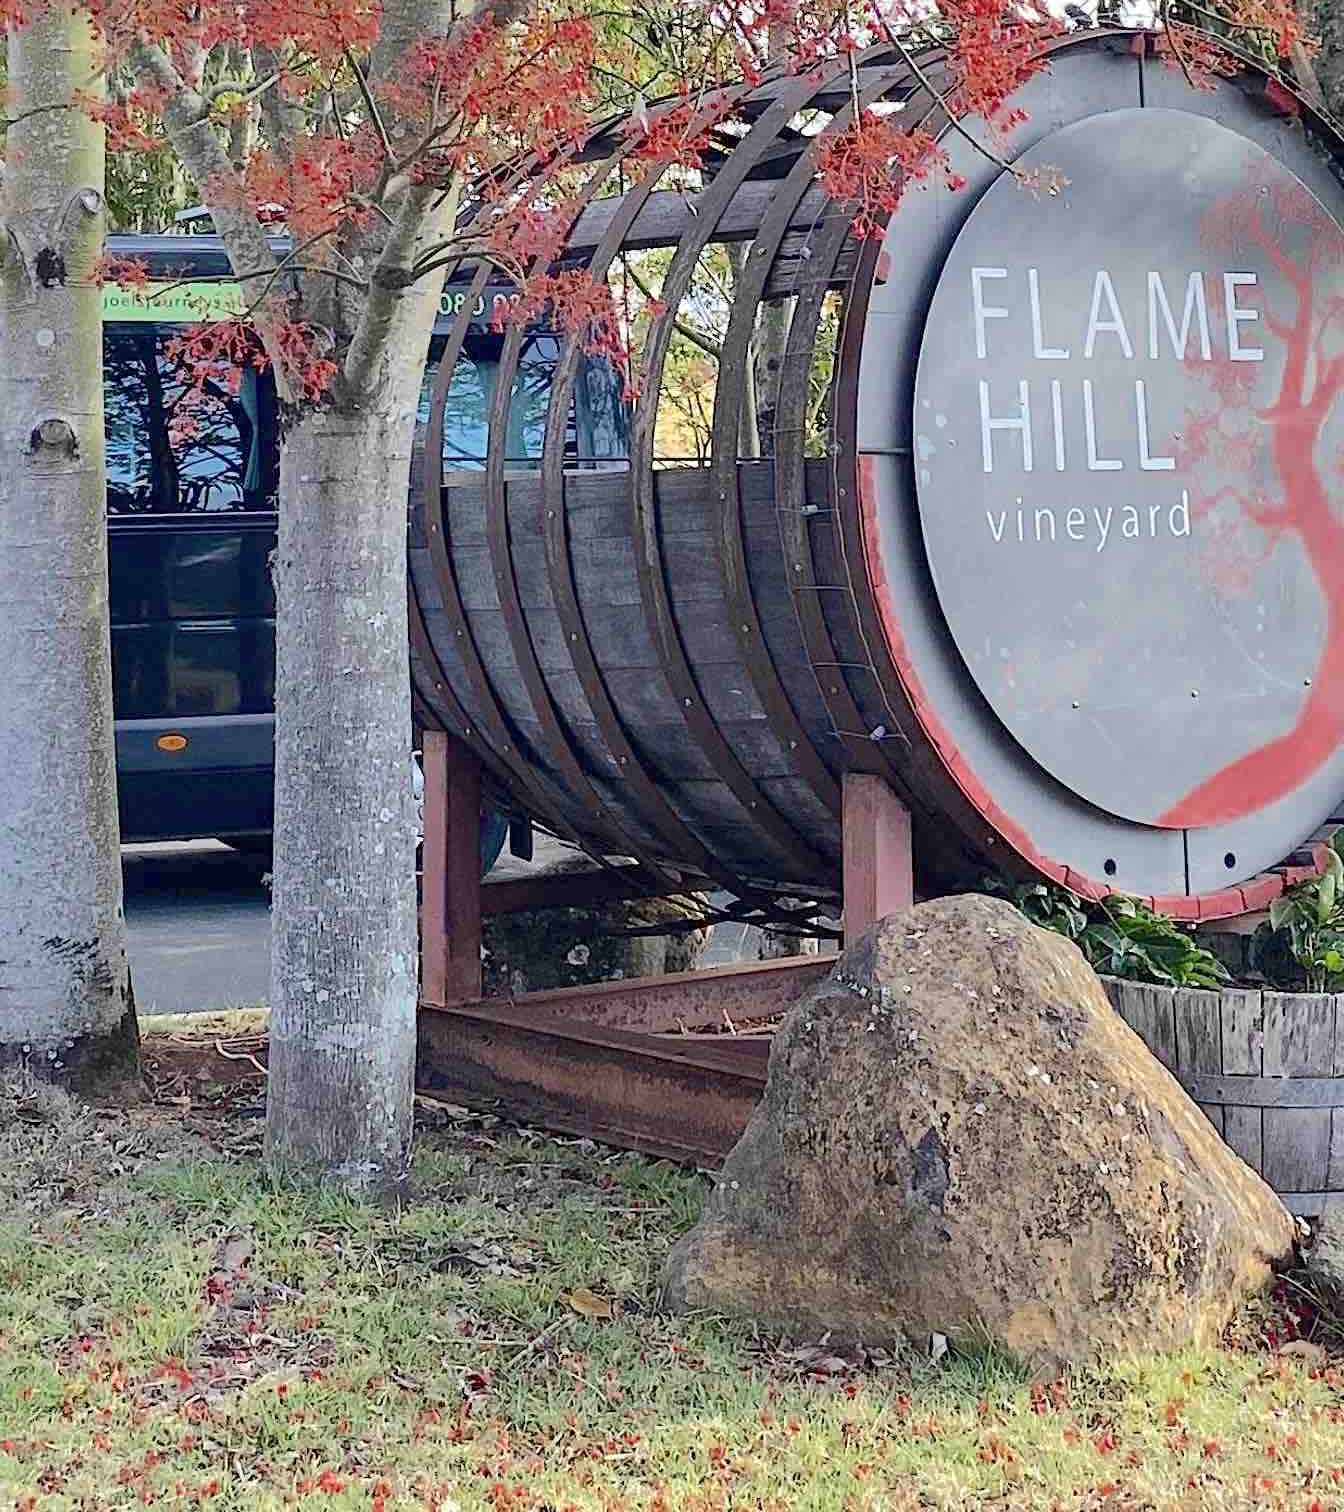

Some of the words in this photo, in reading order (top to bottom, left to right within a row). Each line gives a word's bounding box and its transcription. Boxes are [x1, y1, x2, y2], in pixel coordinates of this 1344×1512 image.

[971, 267, 1264, 361] FLAME
[979, 379, 1176, 473] HILL
[985, 489, 1192, 552] vineyard
